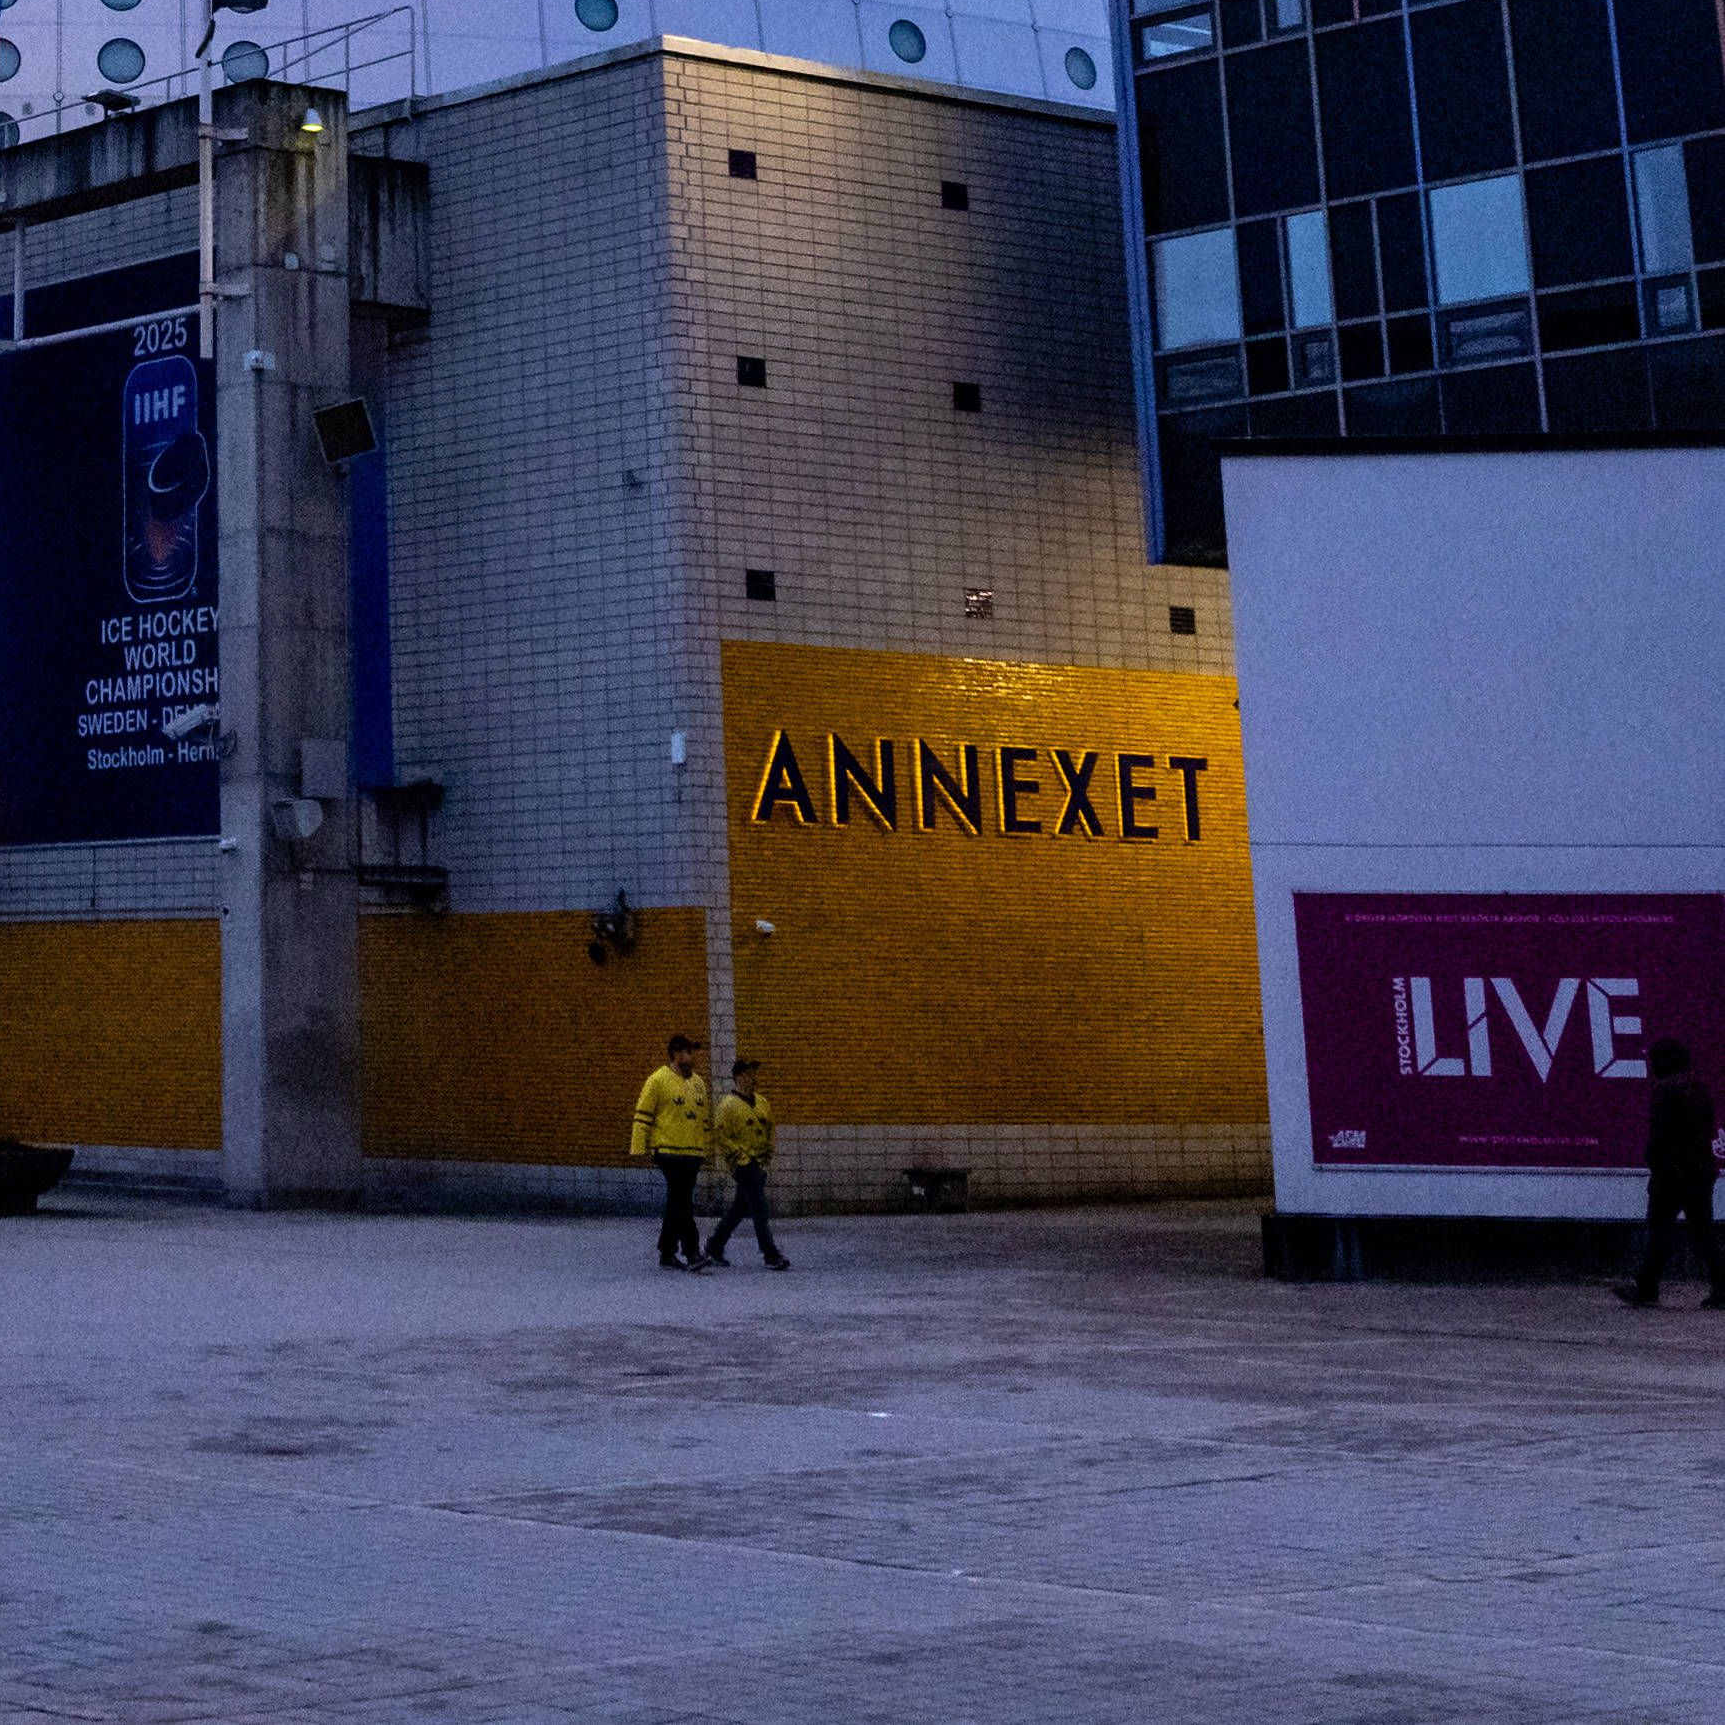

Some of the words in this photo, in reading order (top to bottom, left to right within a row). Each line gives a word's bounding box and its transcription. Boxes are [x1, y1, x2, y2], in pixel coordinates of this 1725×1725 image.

[133, 317, 187, 357] 2025
[134, 384, 186, 425] IIHF
[101, 616, 133, 644] ICE
[139, 606, 219, 639] HOCKEY
[124, 639, 196, 671] WORLD
[86, 666, 219, 705] CHAMPIONSH
[78, 709, 148, 738] SWEDEN
[87, 744, 164, 770] Stockholm
[752, 729, 1208, 842] ANNEXET
[1392, 977, 1413, 1075] STOCKHOLM
[1409, 976, 1648, 1083] LIVE
